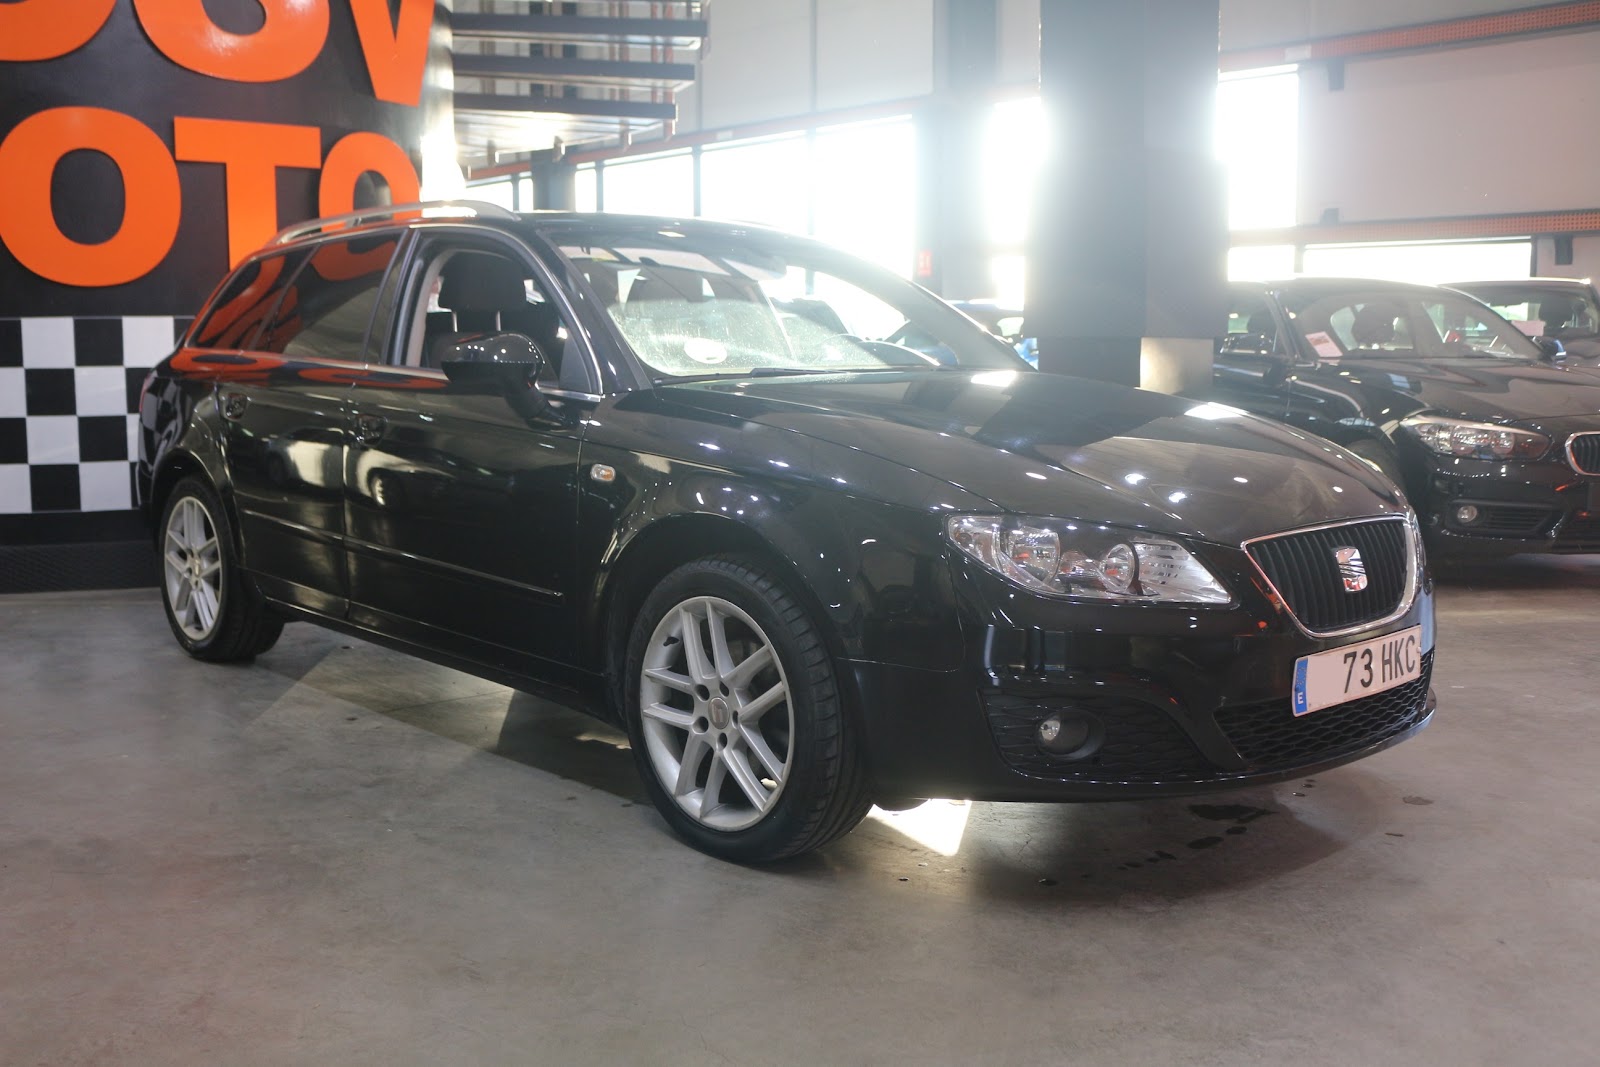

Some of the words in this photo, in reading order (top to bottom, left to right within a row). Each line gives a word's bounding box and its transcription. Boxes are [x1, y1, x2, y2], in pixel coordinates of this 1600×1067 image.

[1343, 648, 1373, 694] 73
[1381, 634, 1416, 683] HKC
[1297, 691, 1304, 705] E
